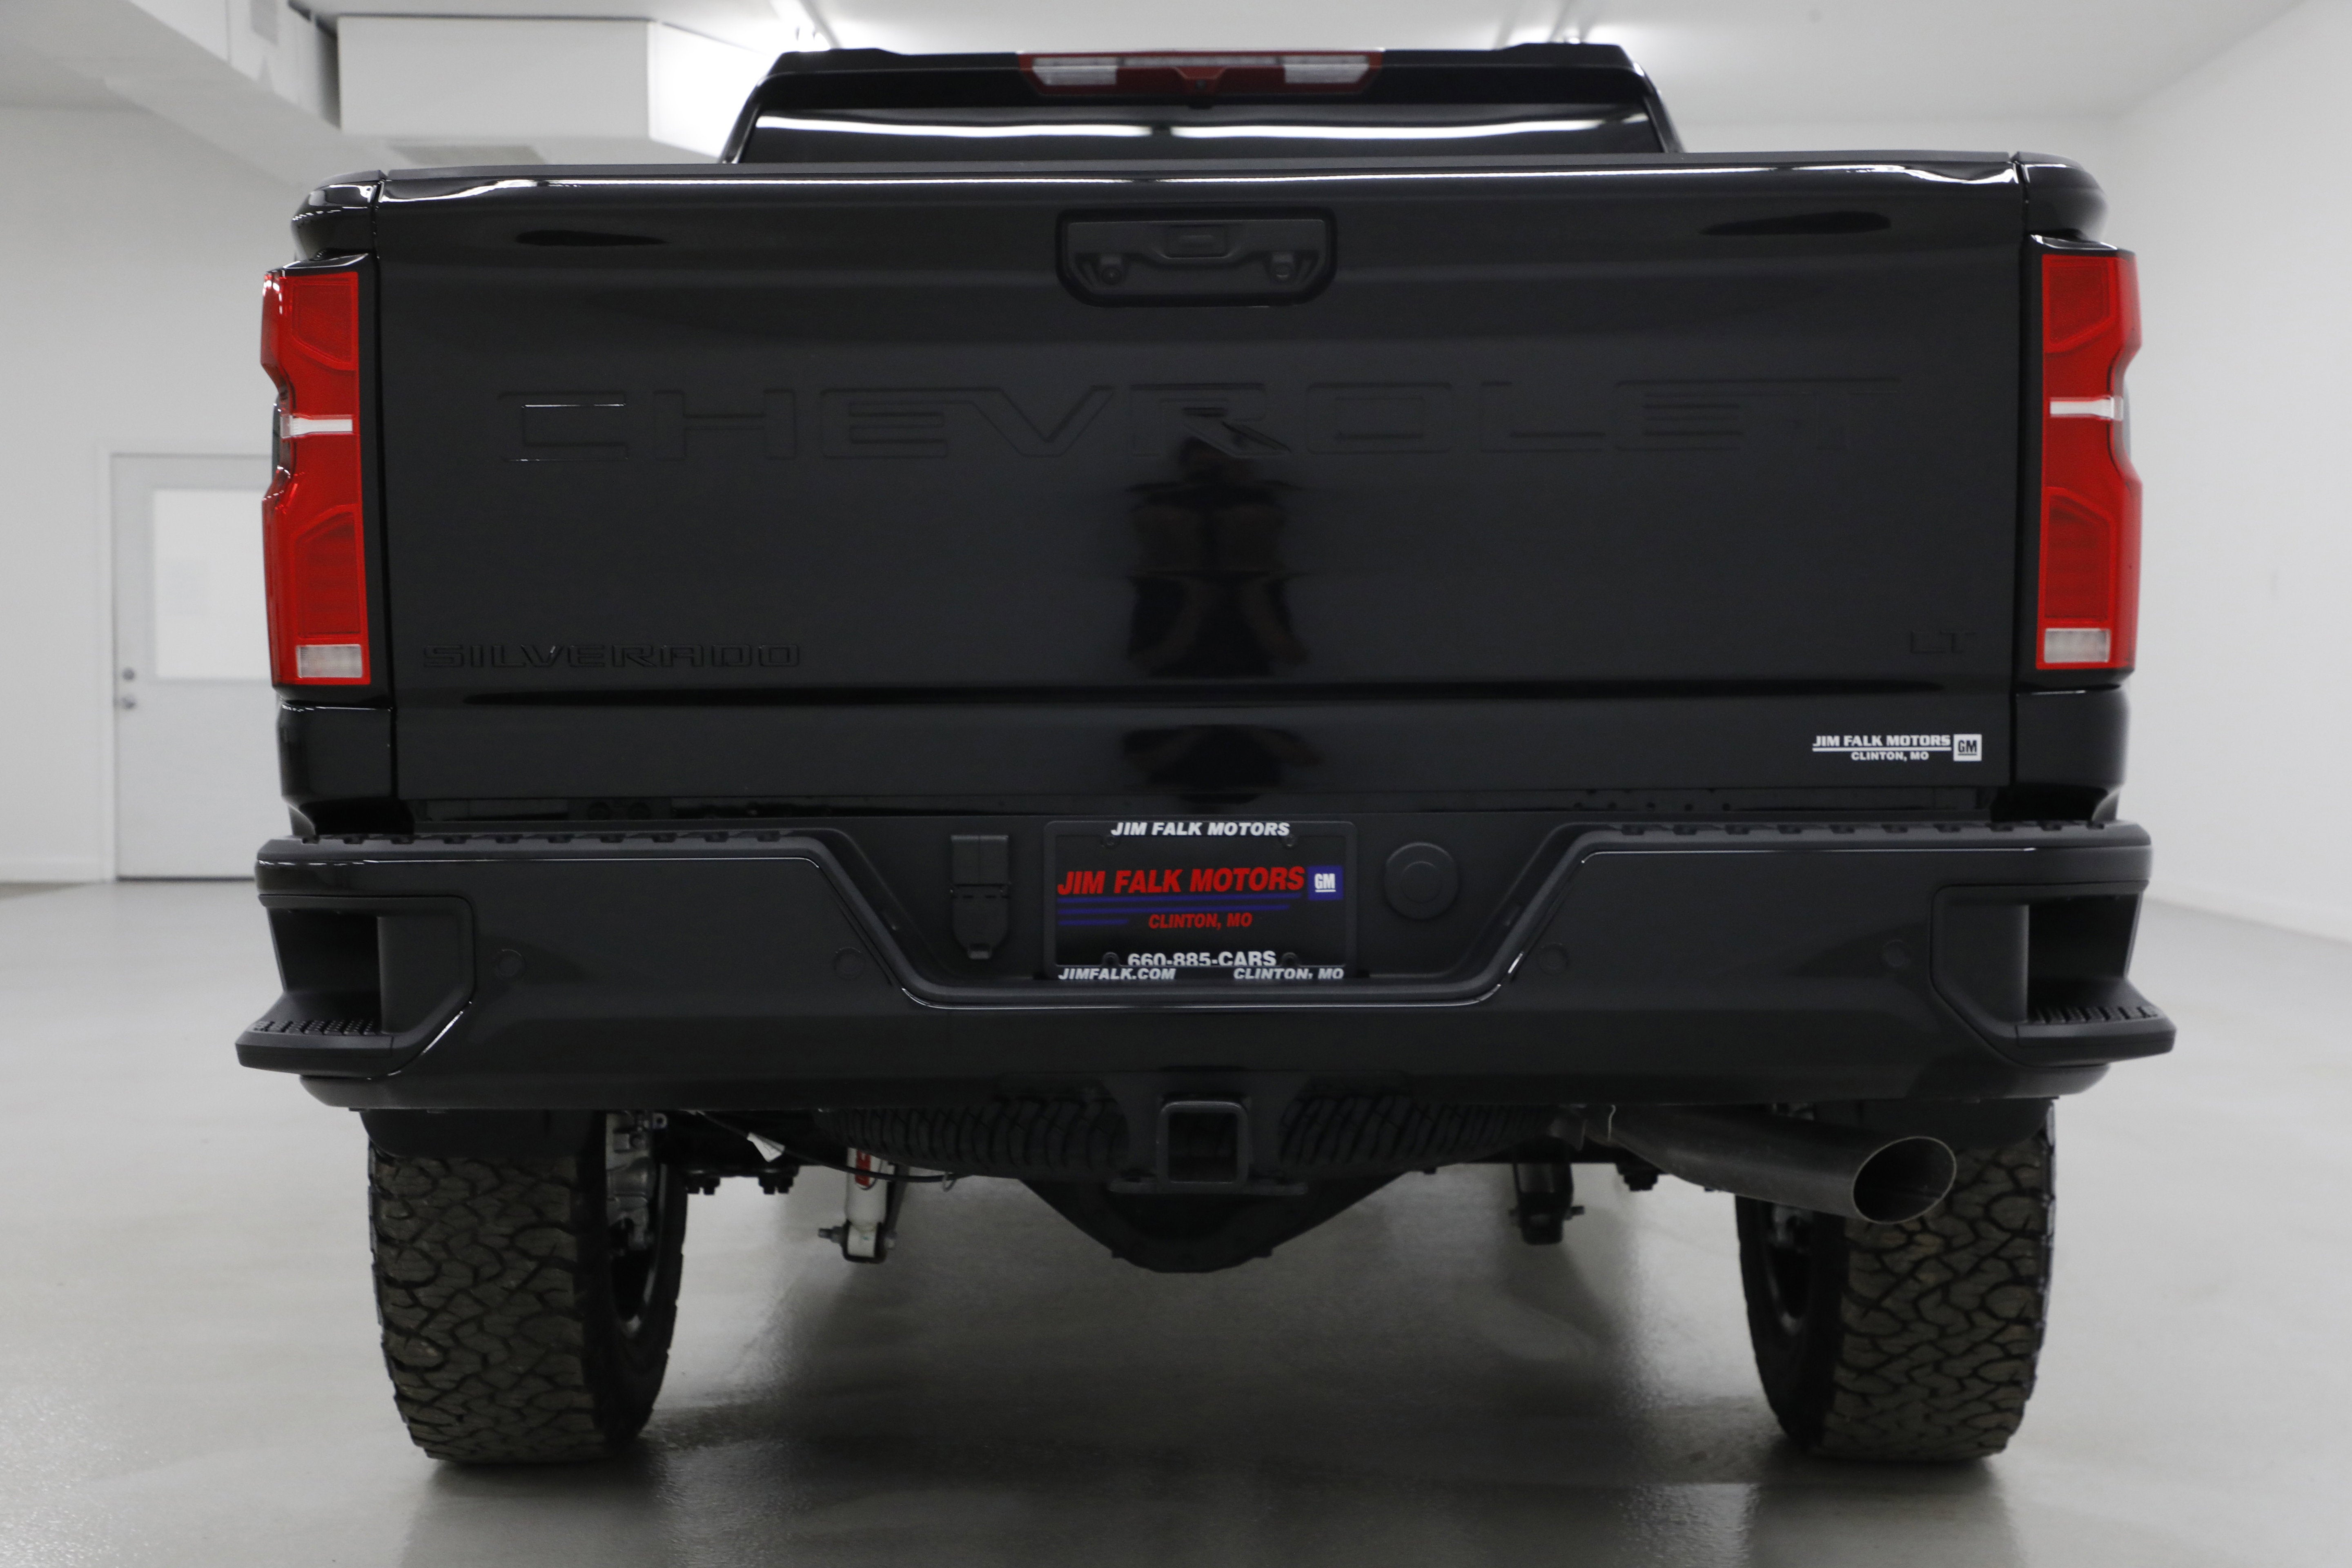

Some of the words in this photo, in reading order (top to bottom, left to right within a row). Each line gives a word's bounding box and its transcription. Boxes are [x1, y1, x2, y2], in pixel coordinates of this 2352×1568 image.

[497, 377, 1903, 461] CHEVROLET
[423, 643, 800, 668] SILVERADO
[1812, 736, 1840, 746] JIM
[1843, 735, 1883, 746] FALK
[1886, 735, 1951, 746] MOTORS
[1958, 740, 1977, 753] GM
[1851, 751, 1907, 761] CLINTON,
[1910, 751, 1929, 760] MO
[1111, 822, 1147, 835] JIM
[1152, 822, 1202, 835] FALK
[1207, 822, 1290, 836] MOTORS
[1058, 871, 1106, 895] JIM
[1114, 869, 1183, 893] FALK
[1189, 866, 1305, 892] MOTORS
[1314, 873, 1336, 889] GM
[1148, 913, 1222, 930] CLINTON,
[1227, 913, 1253, 927] MO
[1128, 951, 1276, 966] 660-885-CARS
[1058, 968, 1176, 980] JIMFALK.COM
[1233, 968, 1313, 980] CLINTON,
[1318, 968, 1344, 979] MO
